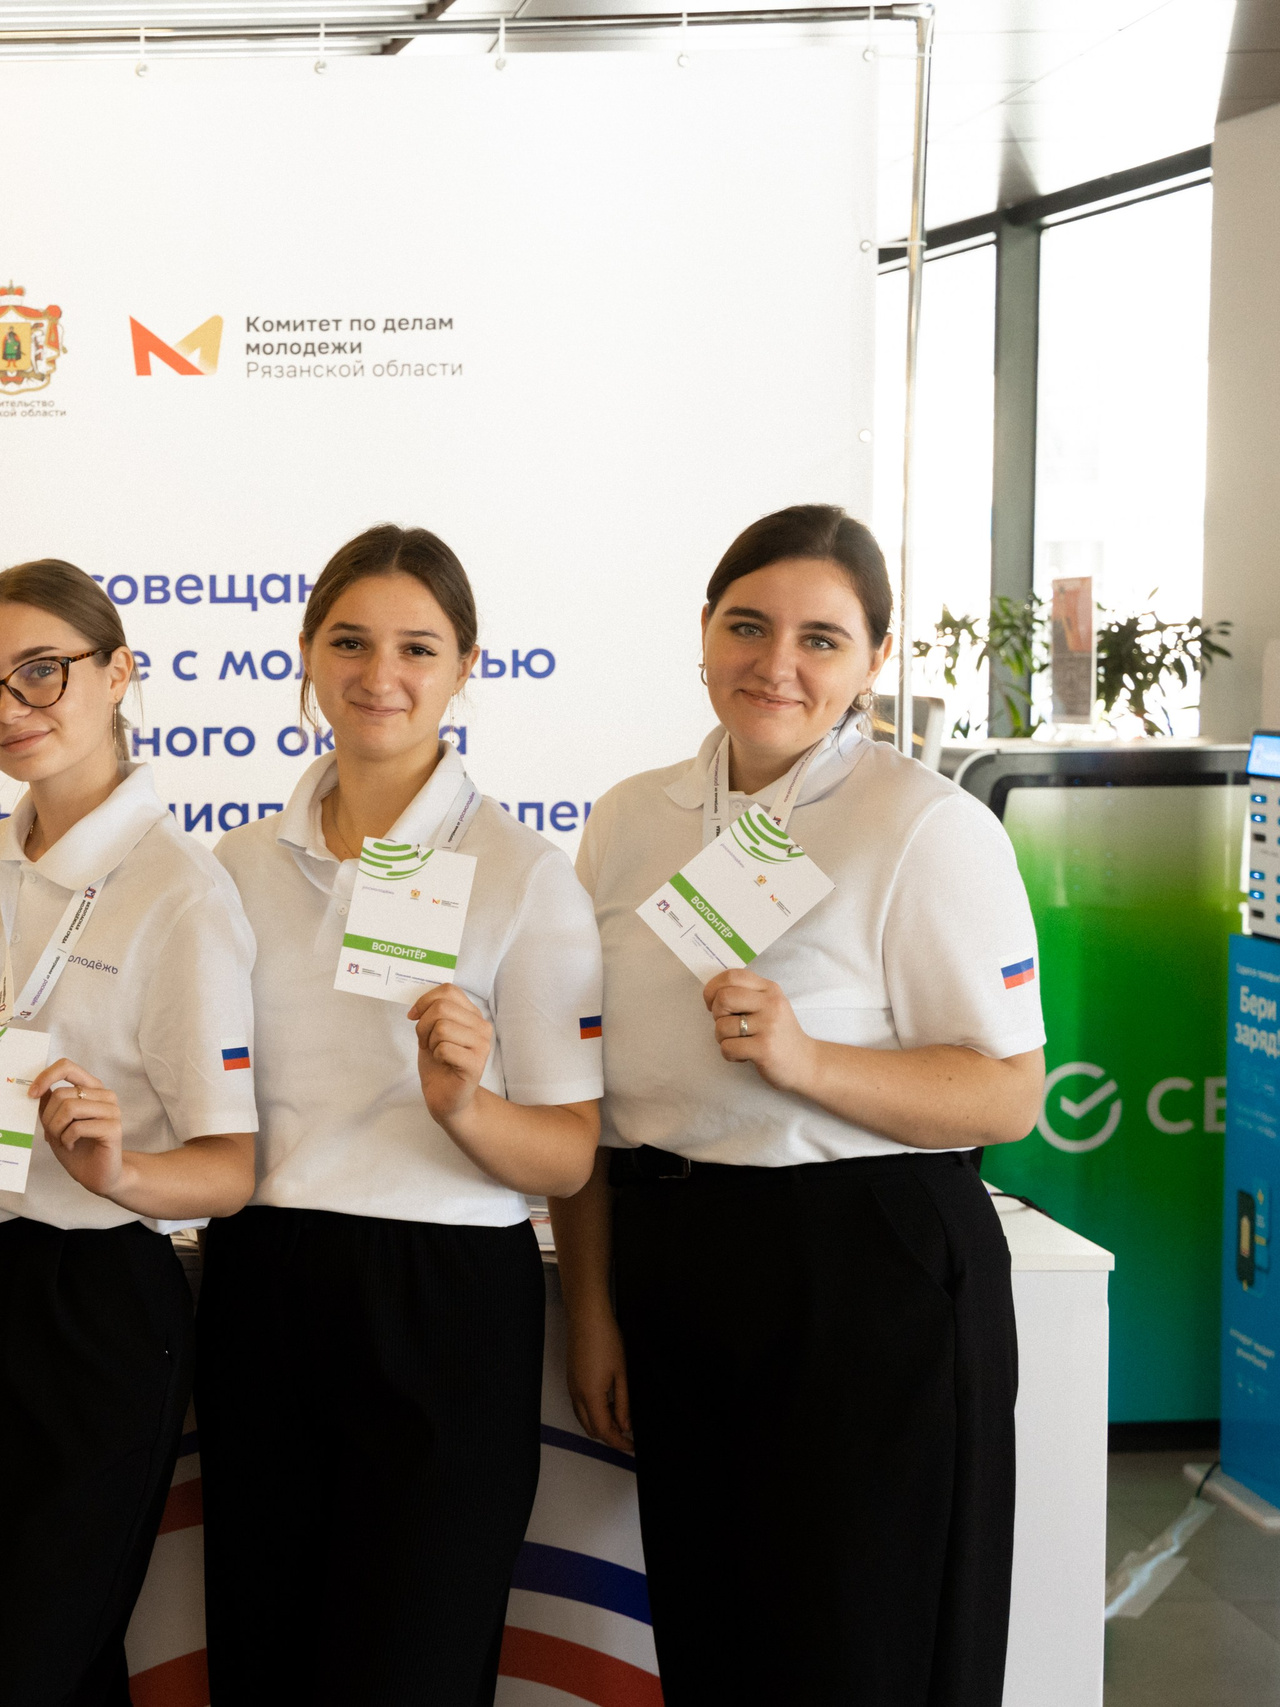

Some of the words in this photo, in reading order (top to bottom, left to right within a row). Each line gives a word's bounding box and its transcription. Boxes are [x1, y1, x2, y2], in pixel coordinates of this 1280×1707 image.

[245, 315, 343, 332] Комитет
[349, 317, 376, 332] по
[382, 317, 455, 334] делам
[245, 341, 363, 357] молодежи
[245, 359, 365, 379] Рязанской
[371, 359, 464, 377] области
[20, 408, 67, 418] области
[172, 650, 198, 681] с
[690, 895, 734, 940] ВОЛОНТЁР
[371, 941, 427, 961] ВОЛОНТЁР
[1240, 985, 1277, 1023] Бери
